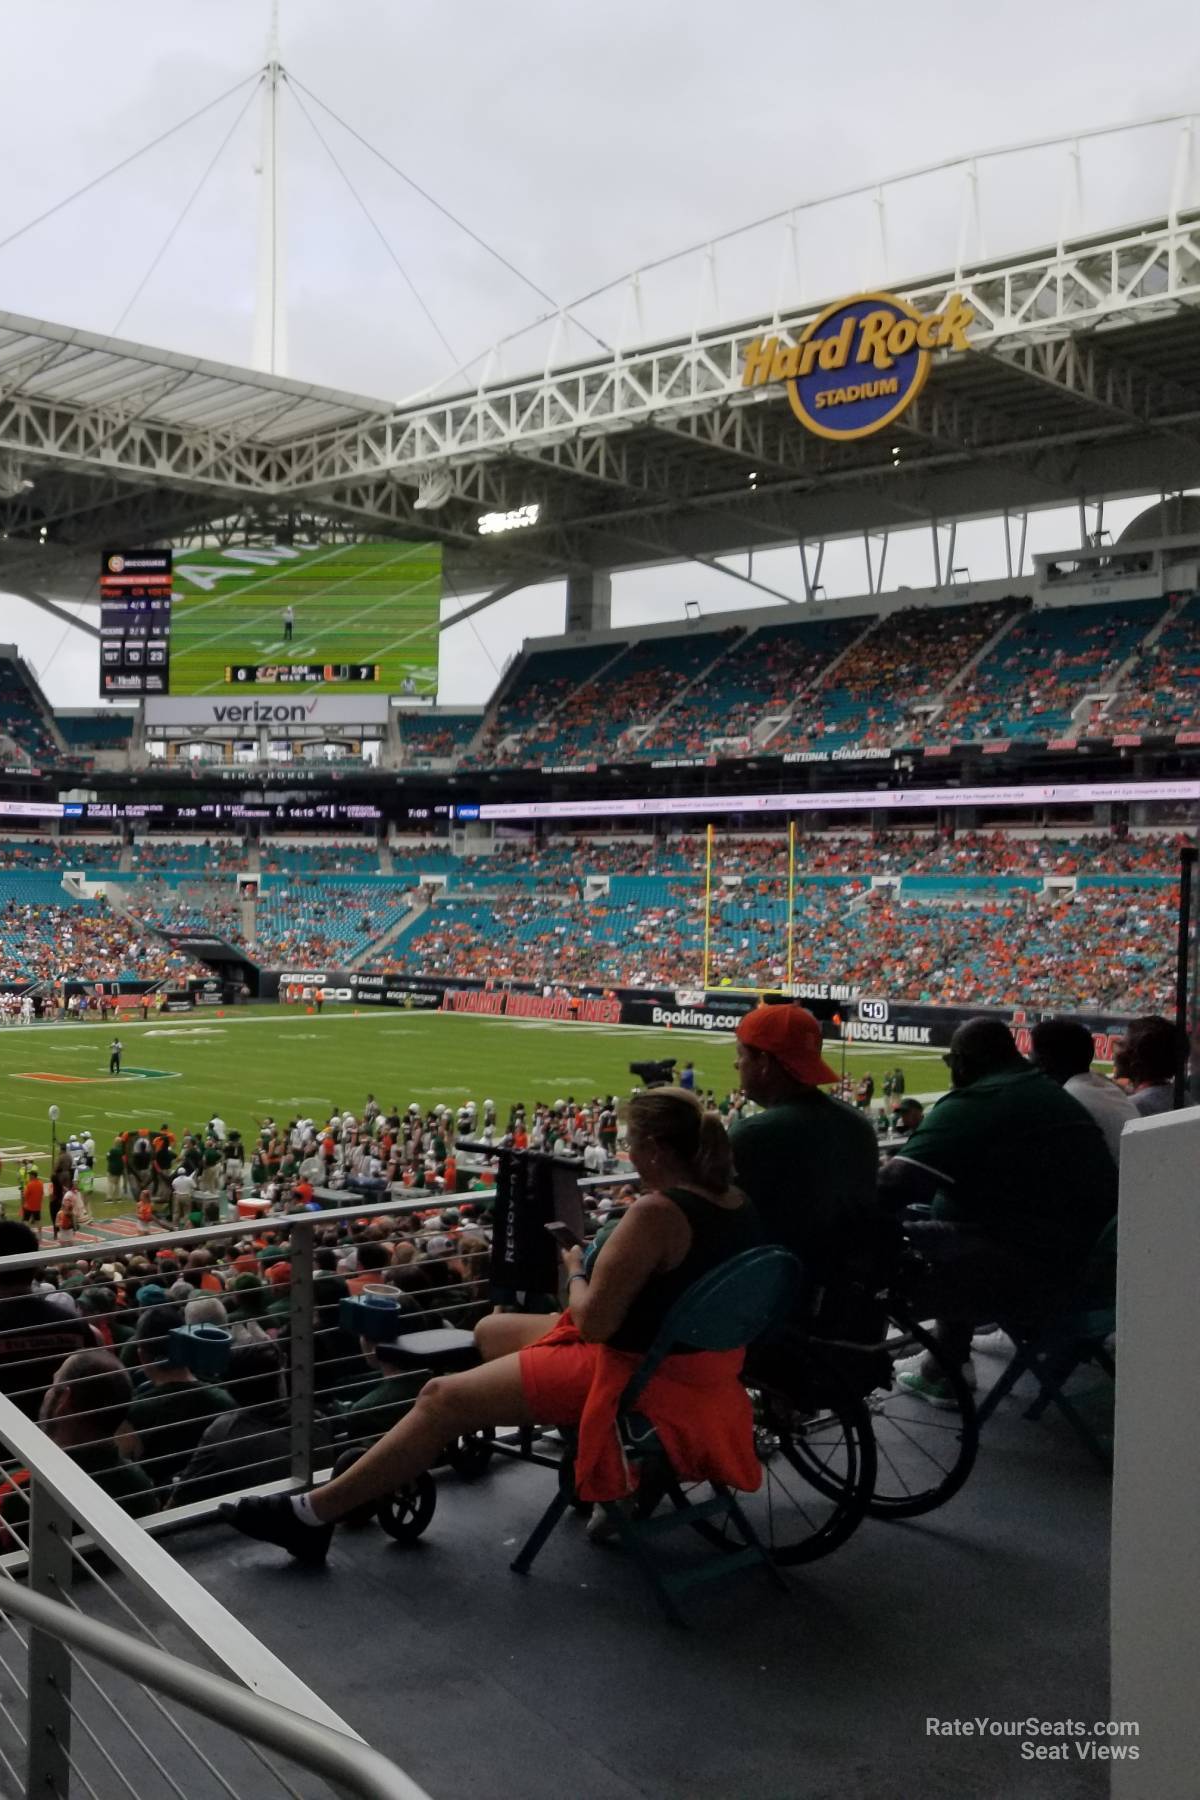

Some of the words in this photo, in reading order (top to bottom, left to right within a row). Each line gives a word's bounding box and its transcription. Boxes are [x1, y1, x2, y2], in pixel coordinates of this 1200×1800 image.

[741, 317, 857, 387] Hard
[857, 293, 975, 369] Rock
[815, 377, 898, 409] STADIUM
[129, 651, 141, 661] 10
[150, 651, 163, 661] 23
[237, 670, 246, 681] 0
[359, 668, 367, 681] 7
[213, 701, 306, 722] verizon
[783, 752, 830, 763] NATIONAL
[832, 747, 892, 761] CHAMPIONS
[280, 974, 327, 984] GEICO
[863, 1002, 884, 1019] 40
[841, 1020, 895, 1042] MUSCLE
[897, 1025, 932, 1044] MILK
